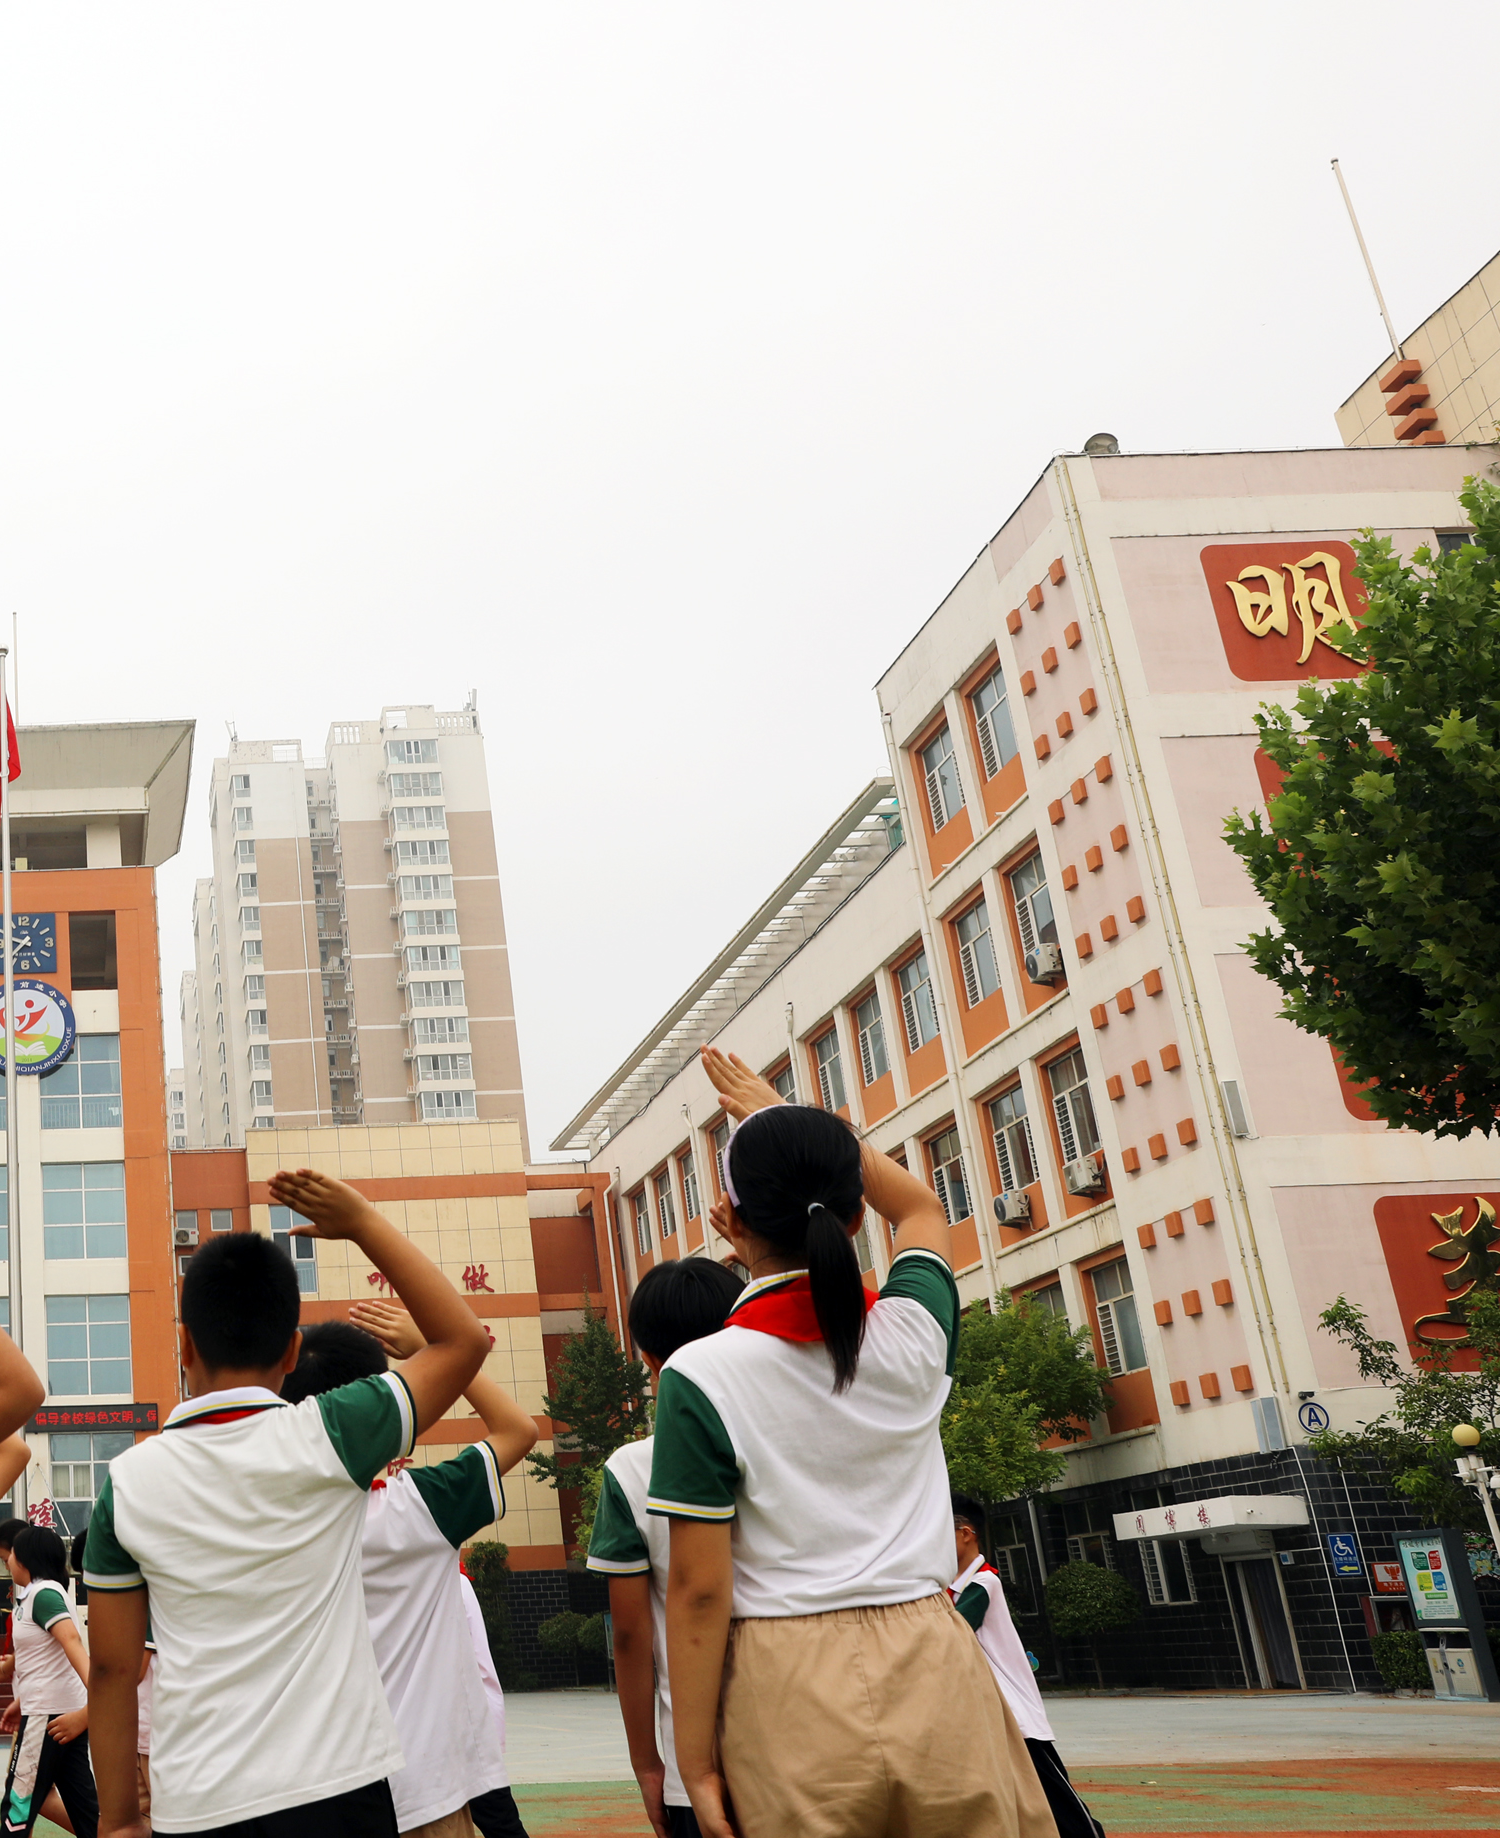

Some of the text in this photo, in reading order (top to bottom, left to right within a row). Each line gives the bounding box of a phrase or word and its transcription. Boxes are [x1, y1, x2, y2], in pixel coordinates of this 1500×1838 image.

[18, 916, 30, 926] 12
[44, 937, 54, 948] 3
[20, 960, 30, 970] 6
[1308, 1407, 1323, 1426] A
